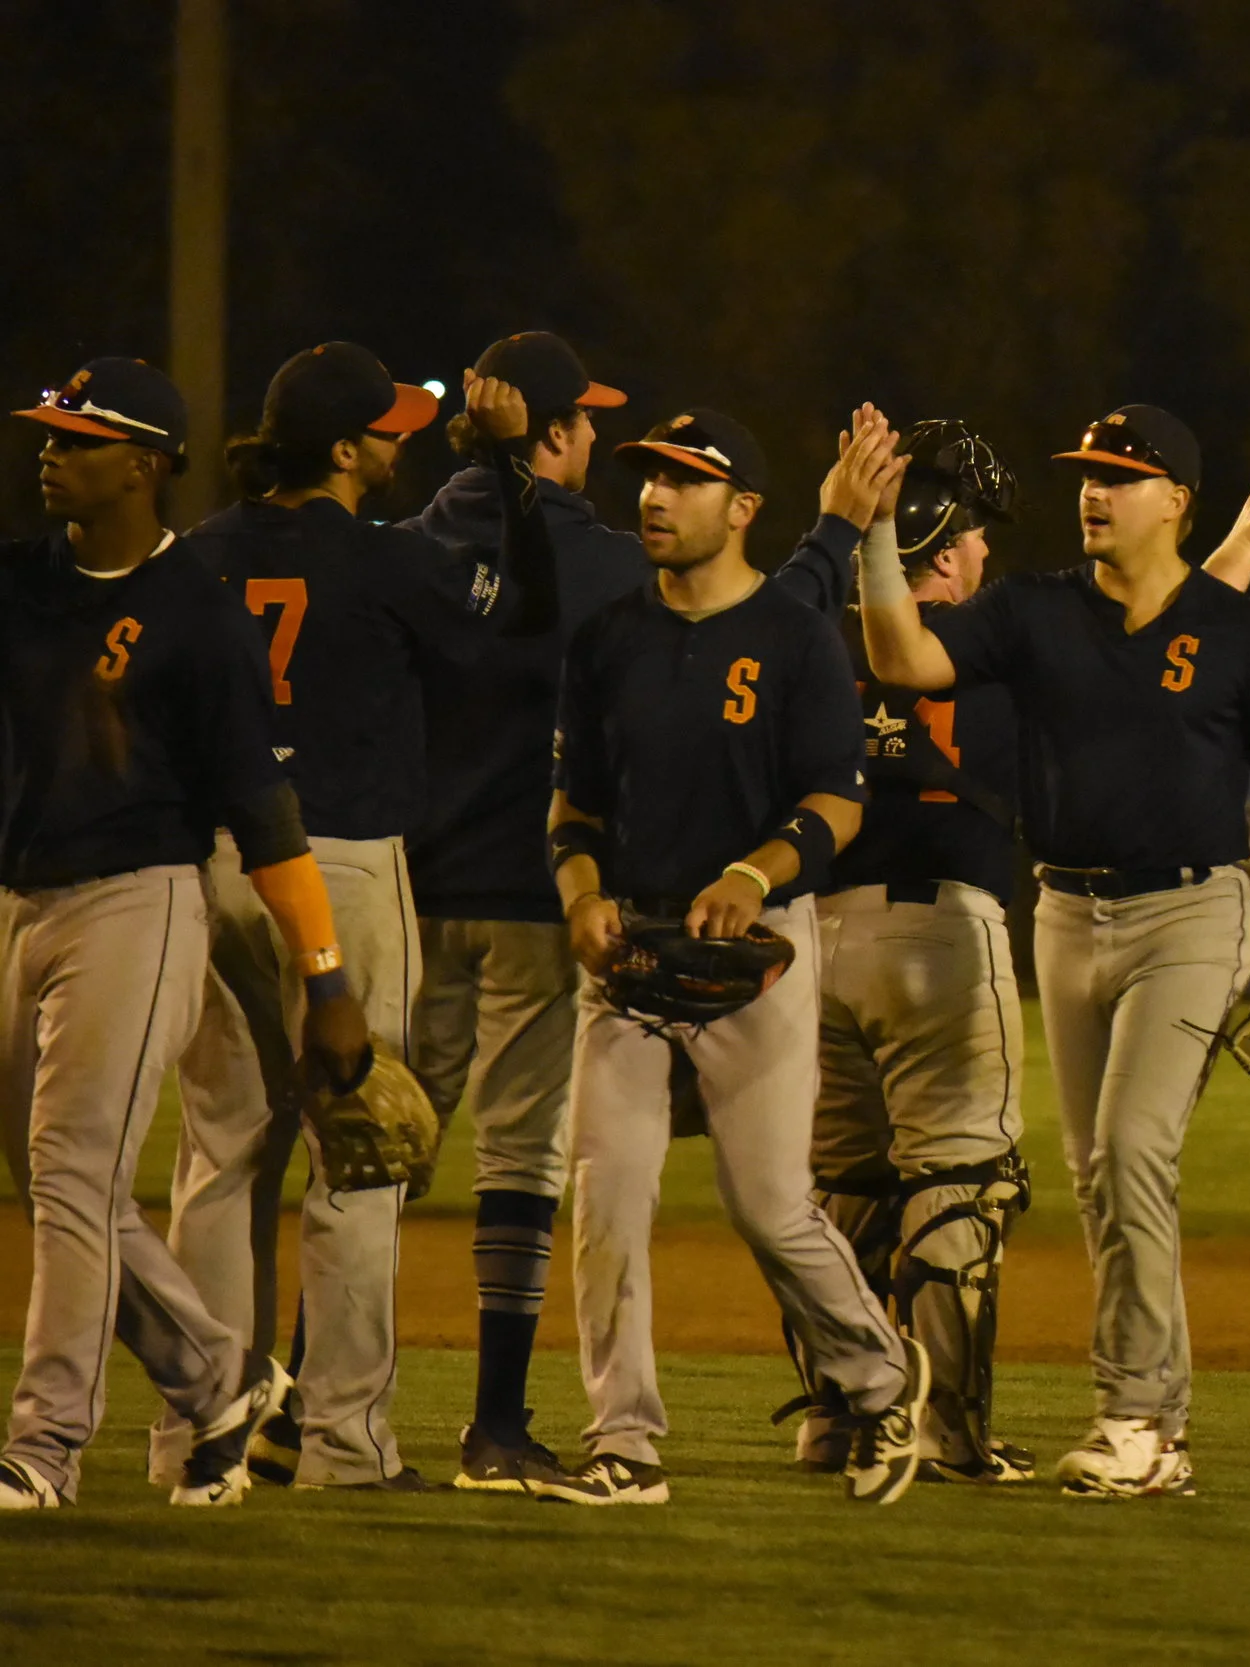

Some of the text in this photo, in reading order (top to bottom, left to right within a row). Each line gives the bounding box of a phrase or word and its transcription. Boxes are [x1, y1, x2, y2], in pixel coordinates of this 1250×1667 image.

[96, 616, 143, 680] S
[245, 578, 308, 705] 7
[1160, 634, 1200, 693] S
[722, 657, 761, 725] S
